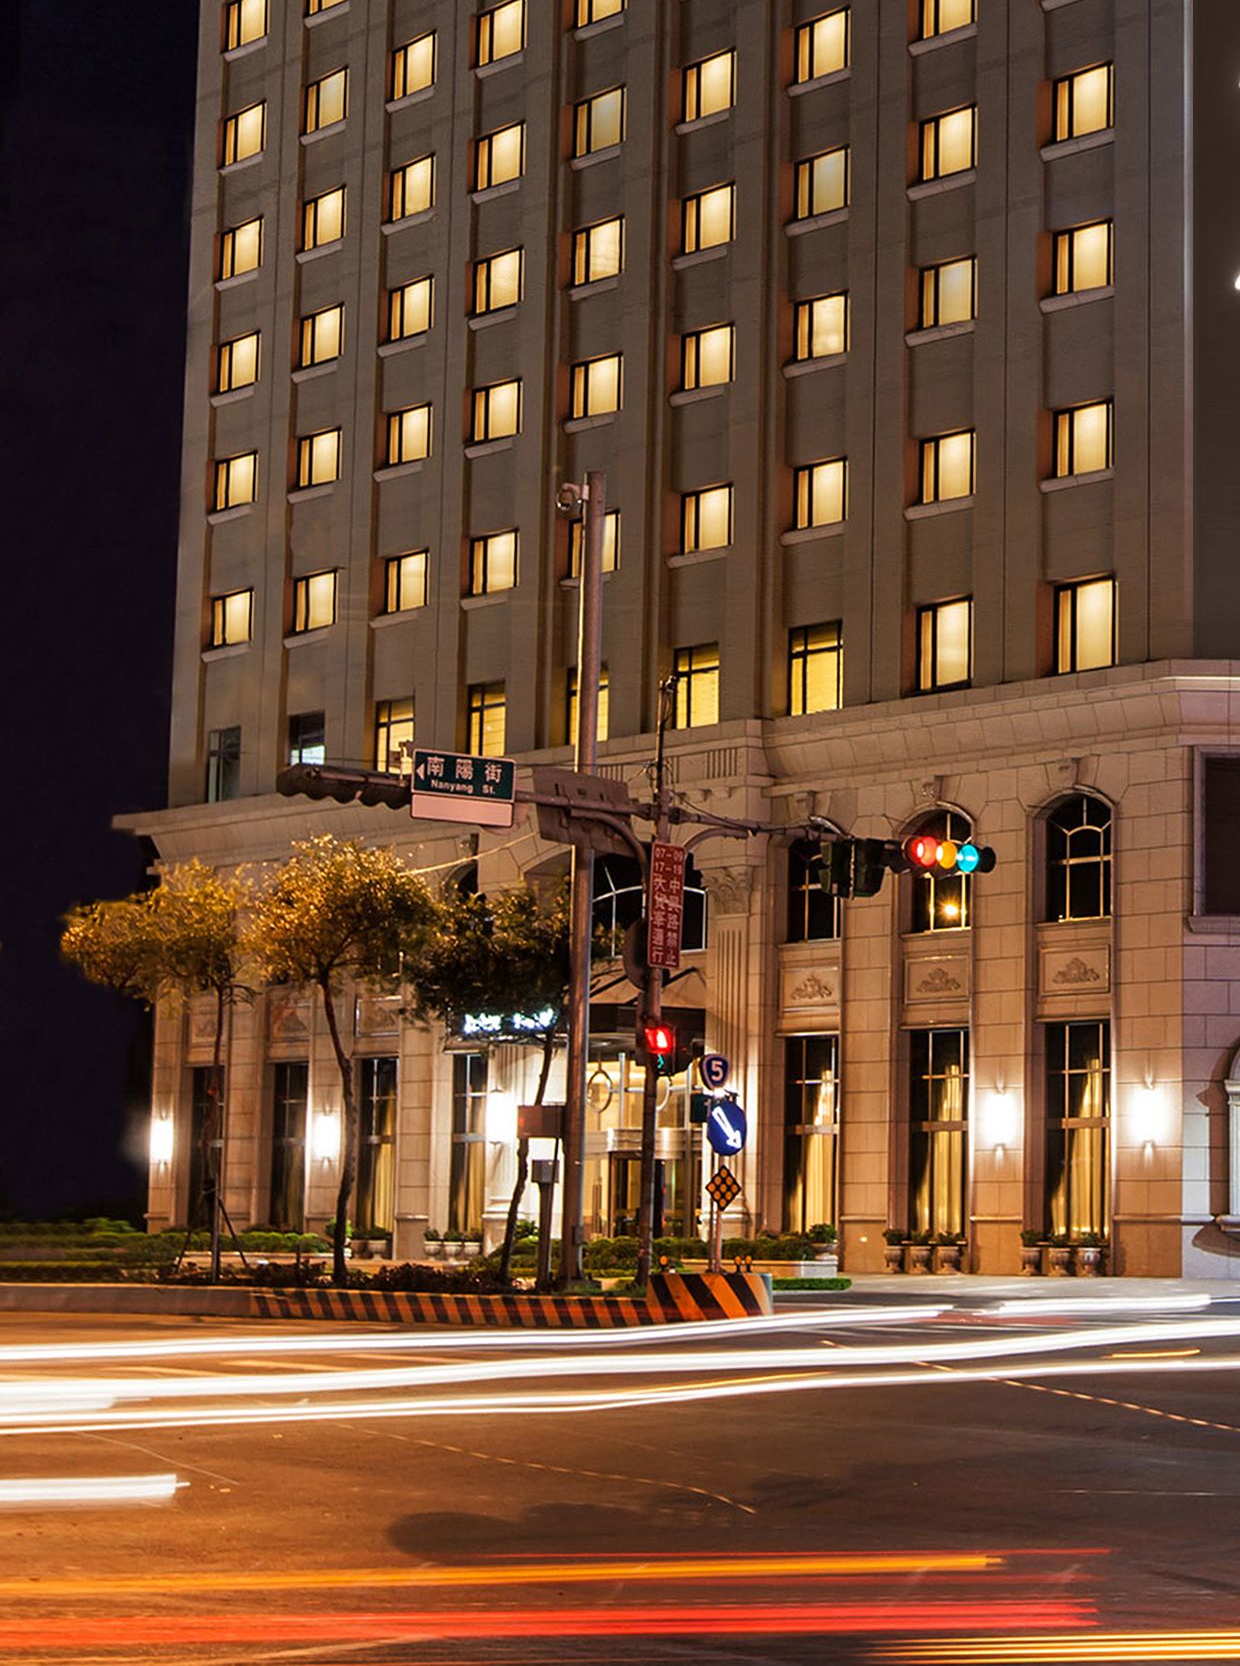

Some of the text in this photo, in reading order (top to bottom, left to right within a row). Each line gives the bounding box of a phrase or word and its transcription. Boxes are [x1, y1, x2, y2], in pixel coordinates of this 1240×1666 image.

[427, 756, 502, 783] 南陽街
[430, 779, 474, 794] Nanyang
[711, 1060, 724, 1082] 5
